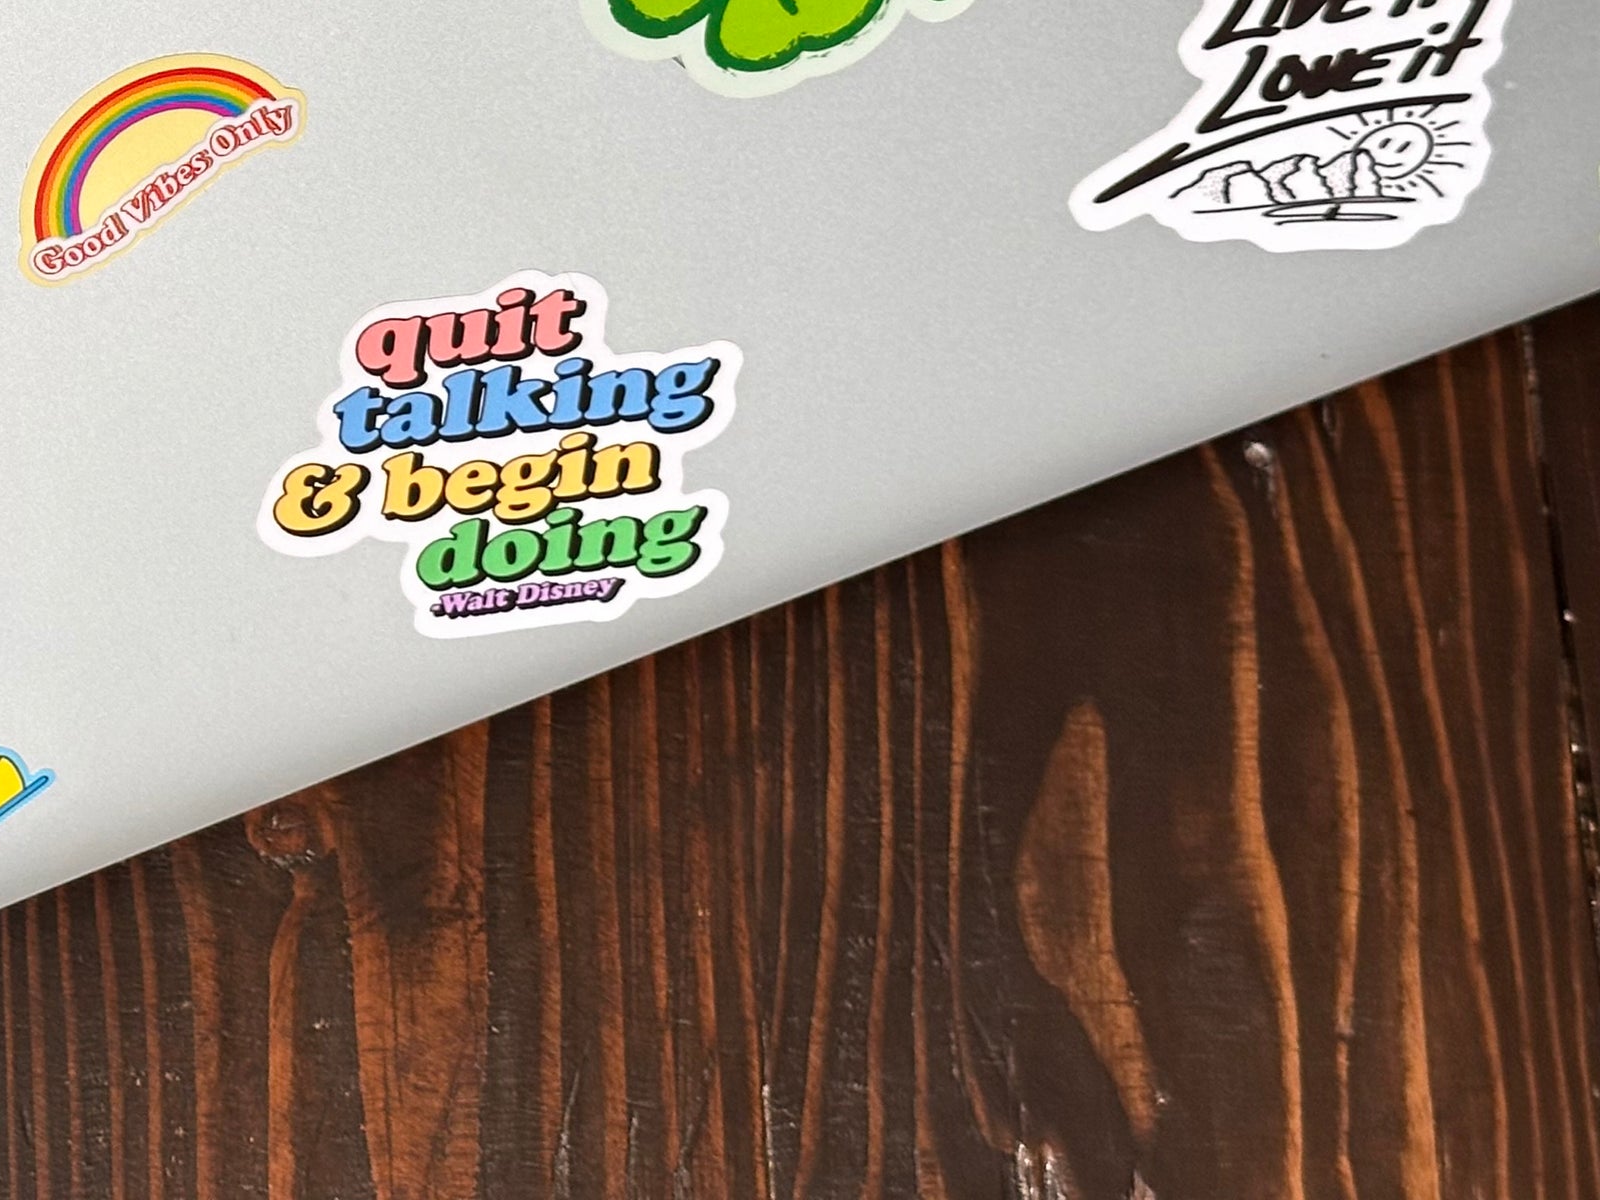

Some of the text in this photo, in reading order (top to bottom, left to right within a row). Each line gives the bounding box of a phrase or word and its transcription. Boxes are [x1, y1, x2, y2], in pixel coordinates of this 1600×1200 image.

[33, 104, 293, 275] Good Vibes Only
[356, 287, 587, 390] quit
[333, 357, 721, 454] talking
[273, 431, 661, 538] & begin
[416, 506, 708, 591] doing
[516, 577, 625, 608] Disney
